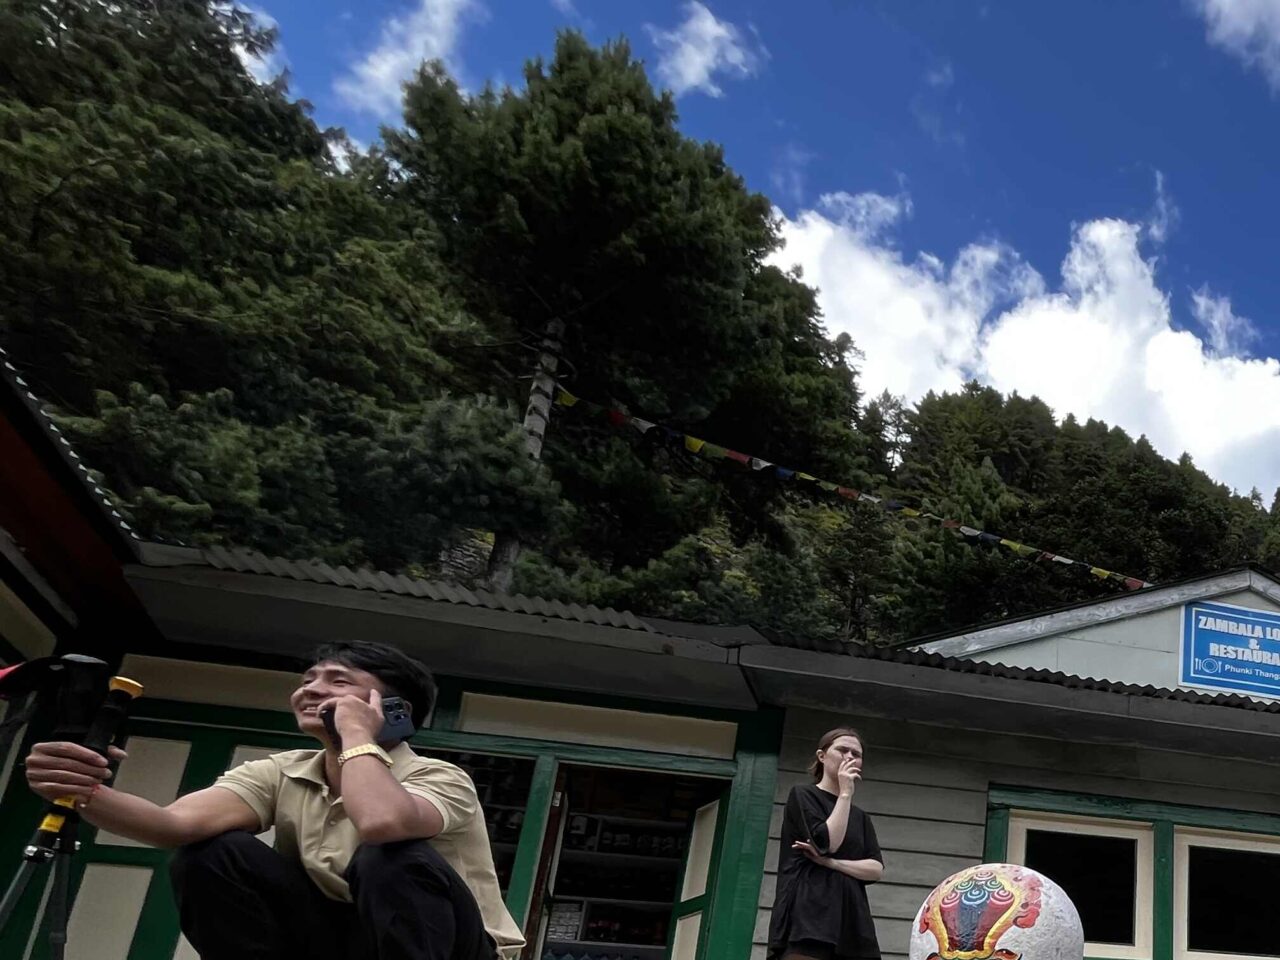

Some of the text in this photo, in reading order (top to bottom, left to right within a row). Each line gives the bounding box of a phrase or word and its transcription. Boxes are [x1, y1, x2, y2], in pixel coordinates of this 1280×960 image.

[1198, 615, 1264, 639] ZAMBALA
[1248, 639, 1260, 650] &
[1225, 664, 1253, 675] Phunki
